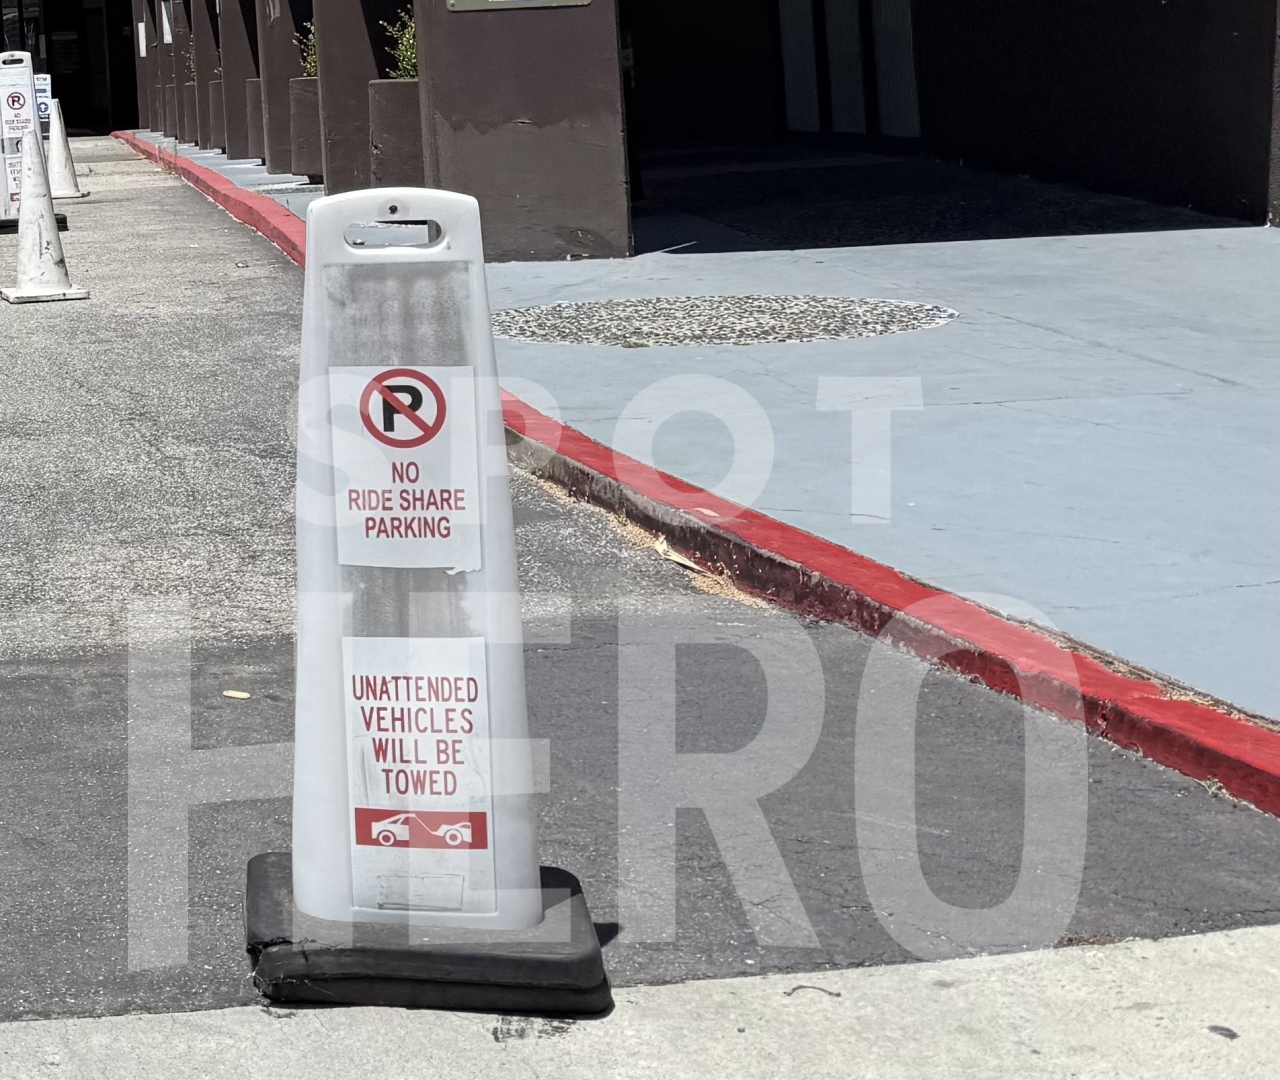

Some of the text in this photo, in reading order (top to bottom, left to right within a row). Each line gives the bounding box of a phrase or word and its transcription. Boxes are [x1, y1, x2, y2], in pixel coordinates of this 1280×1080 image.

[392, 461, 420, 484] NO
[348, 488, 466, 511] RIDE SHARE
[365, 516, 451, 539] PARKING
[352, 674, 479, 703] UNATTENDED
[361, 706, 474, 734] VEHICLES
[372, 737, 465, 765] WILL BE
[381, 768, 458, 796] TOWED
